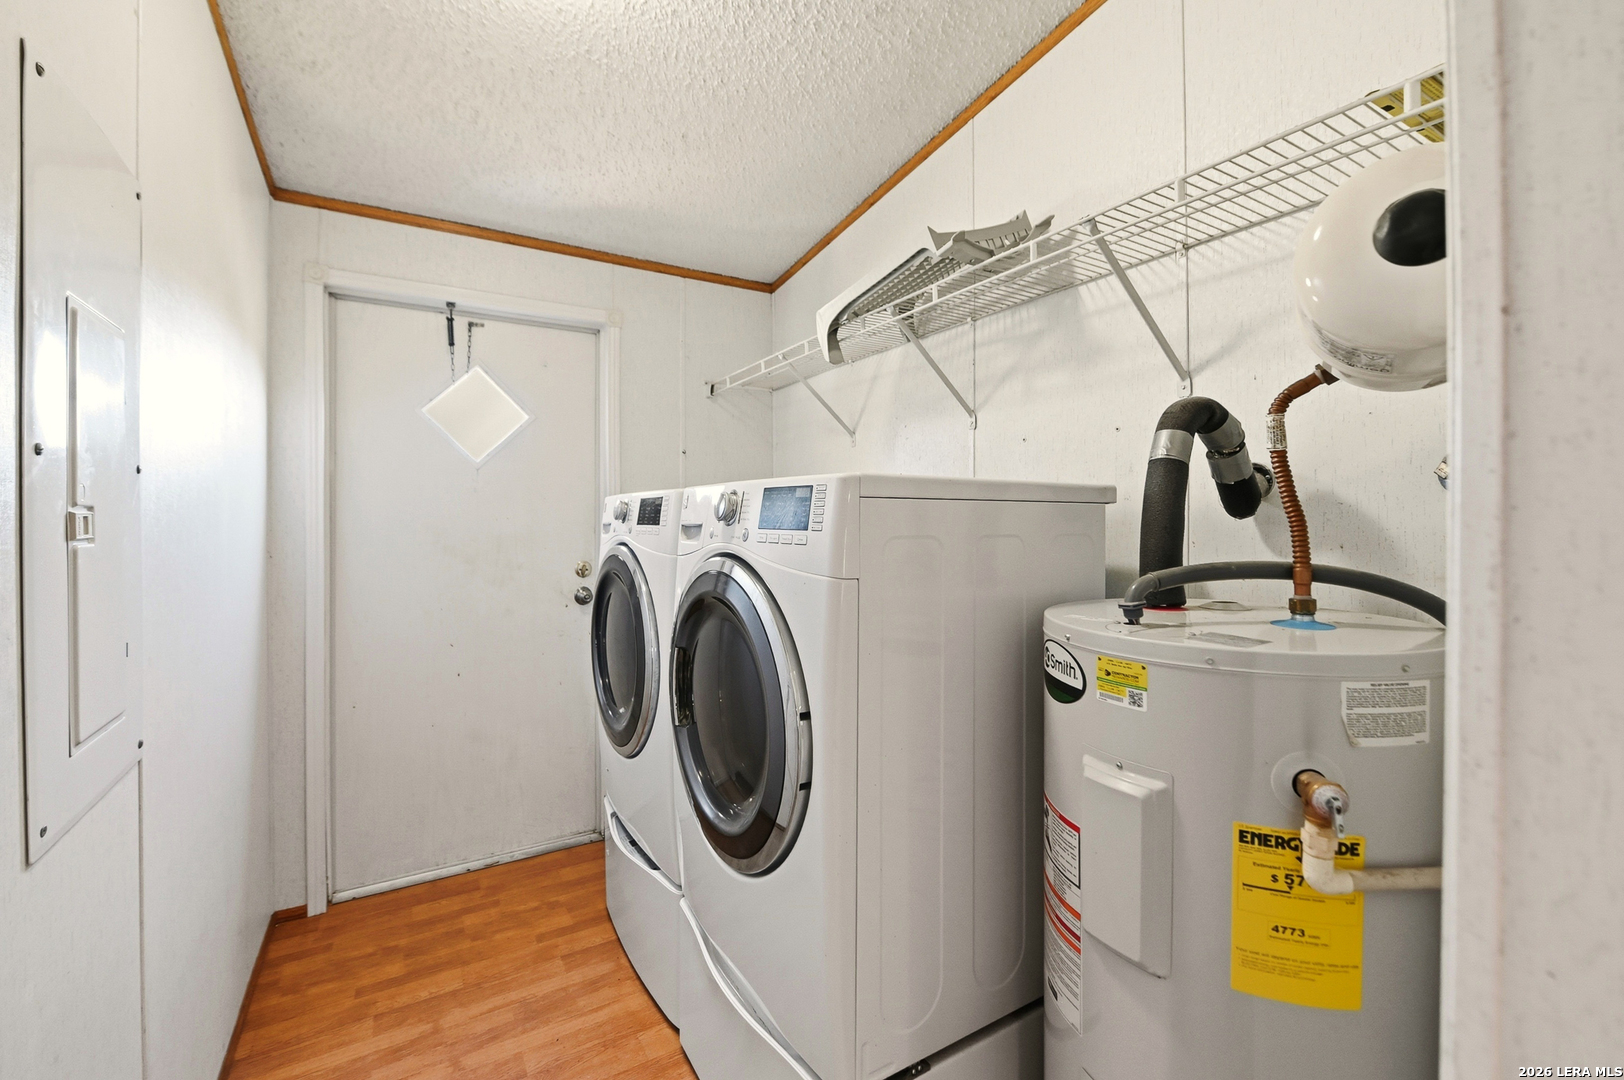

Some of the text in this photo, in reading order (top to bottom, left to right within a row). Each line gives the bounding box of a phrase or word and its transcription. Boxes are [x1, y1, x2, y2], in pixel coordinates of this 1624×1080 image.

[1050, 653, 1076, 680] Smith
[1270, 873, 1279, 883] $
[1271, 924, 1306, 938] 4773
